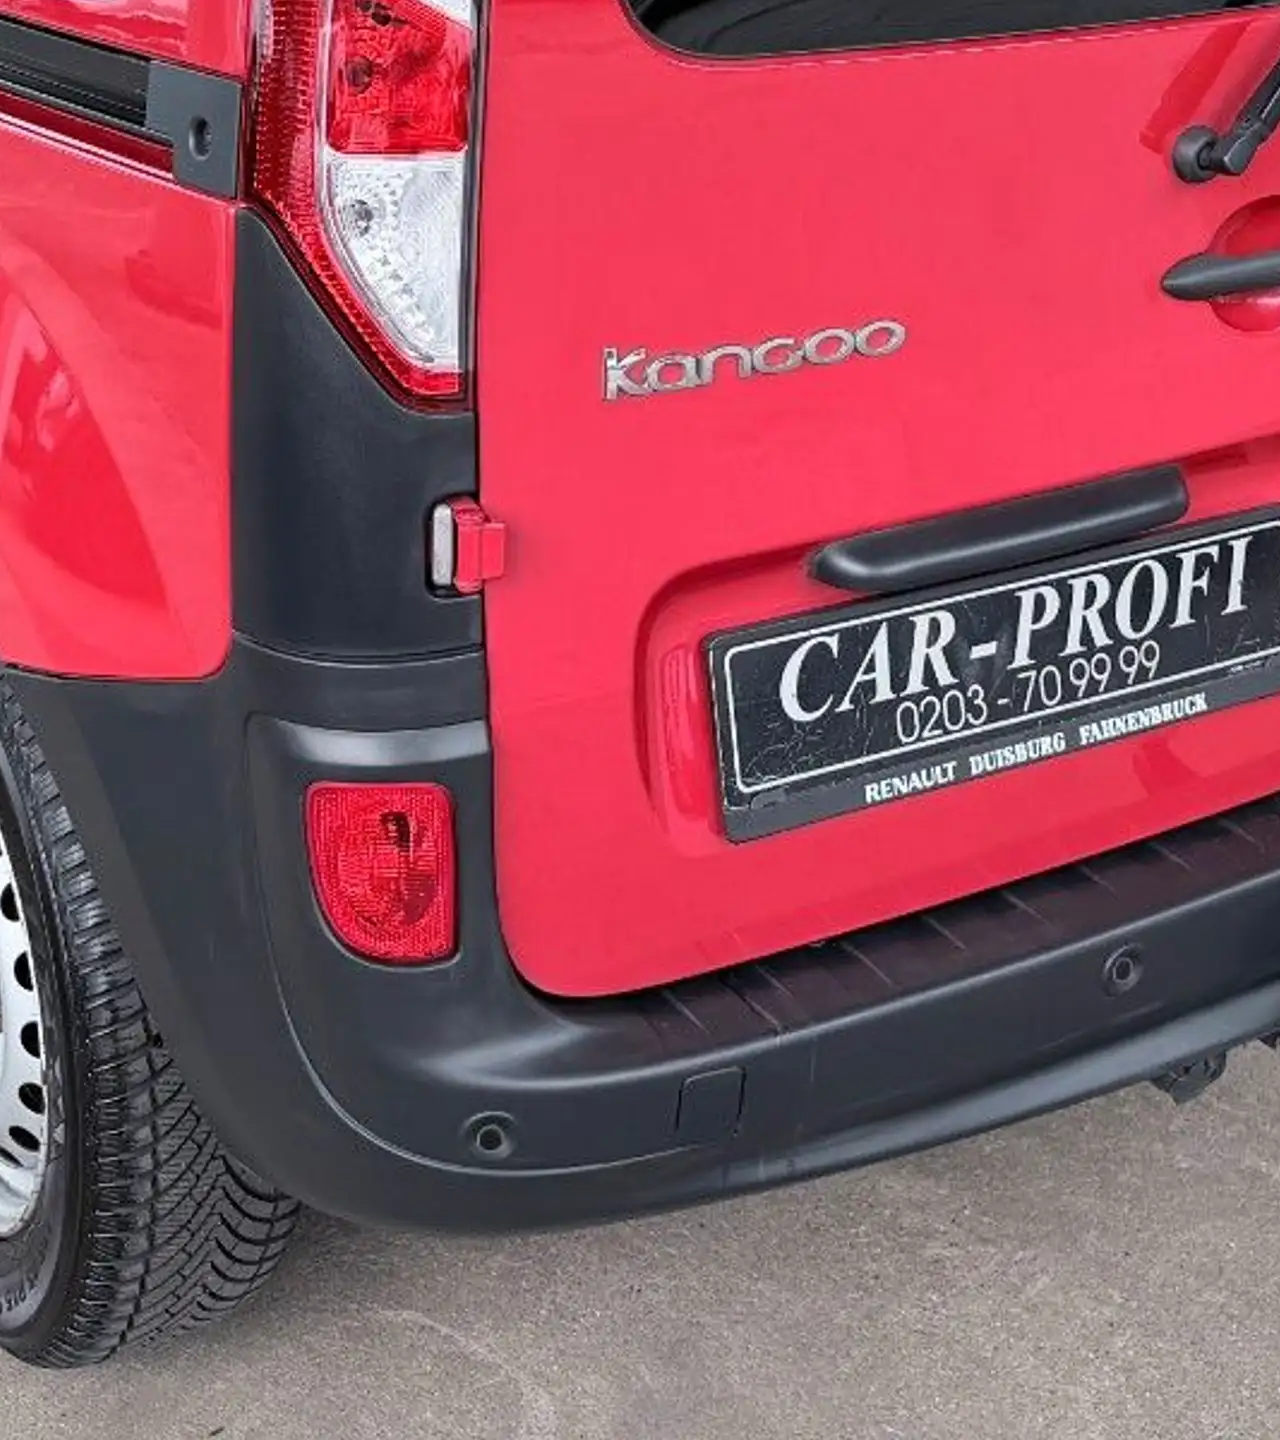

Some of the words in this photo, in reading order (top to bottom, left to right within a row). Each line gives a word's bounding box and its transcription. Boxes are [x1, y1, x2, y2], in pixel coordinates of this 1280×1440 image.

[778, 535, 1254, 722] CAR-PROFI
[896, 684, 988, 745] 0203
[1017, 664, 1062, 715] 70
[1069, 651, 1112, 699] 99
[1119, 639, 1161, 686] 99
[864, 761, 958, 804] RENAULT
[969, 731, 1067, 776] DUISBURG
